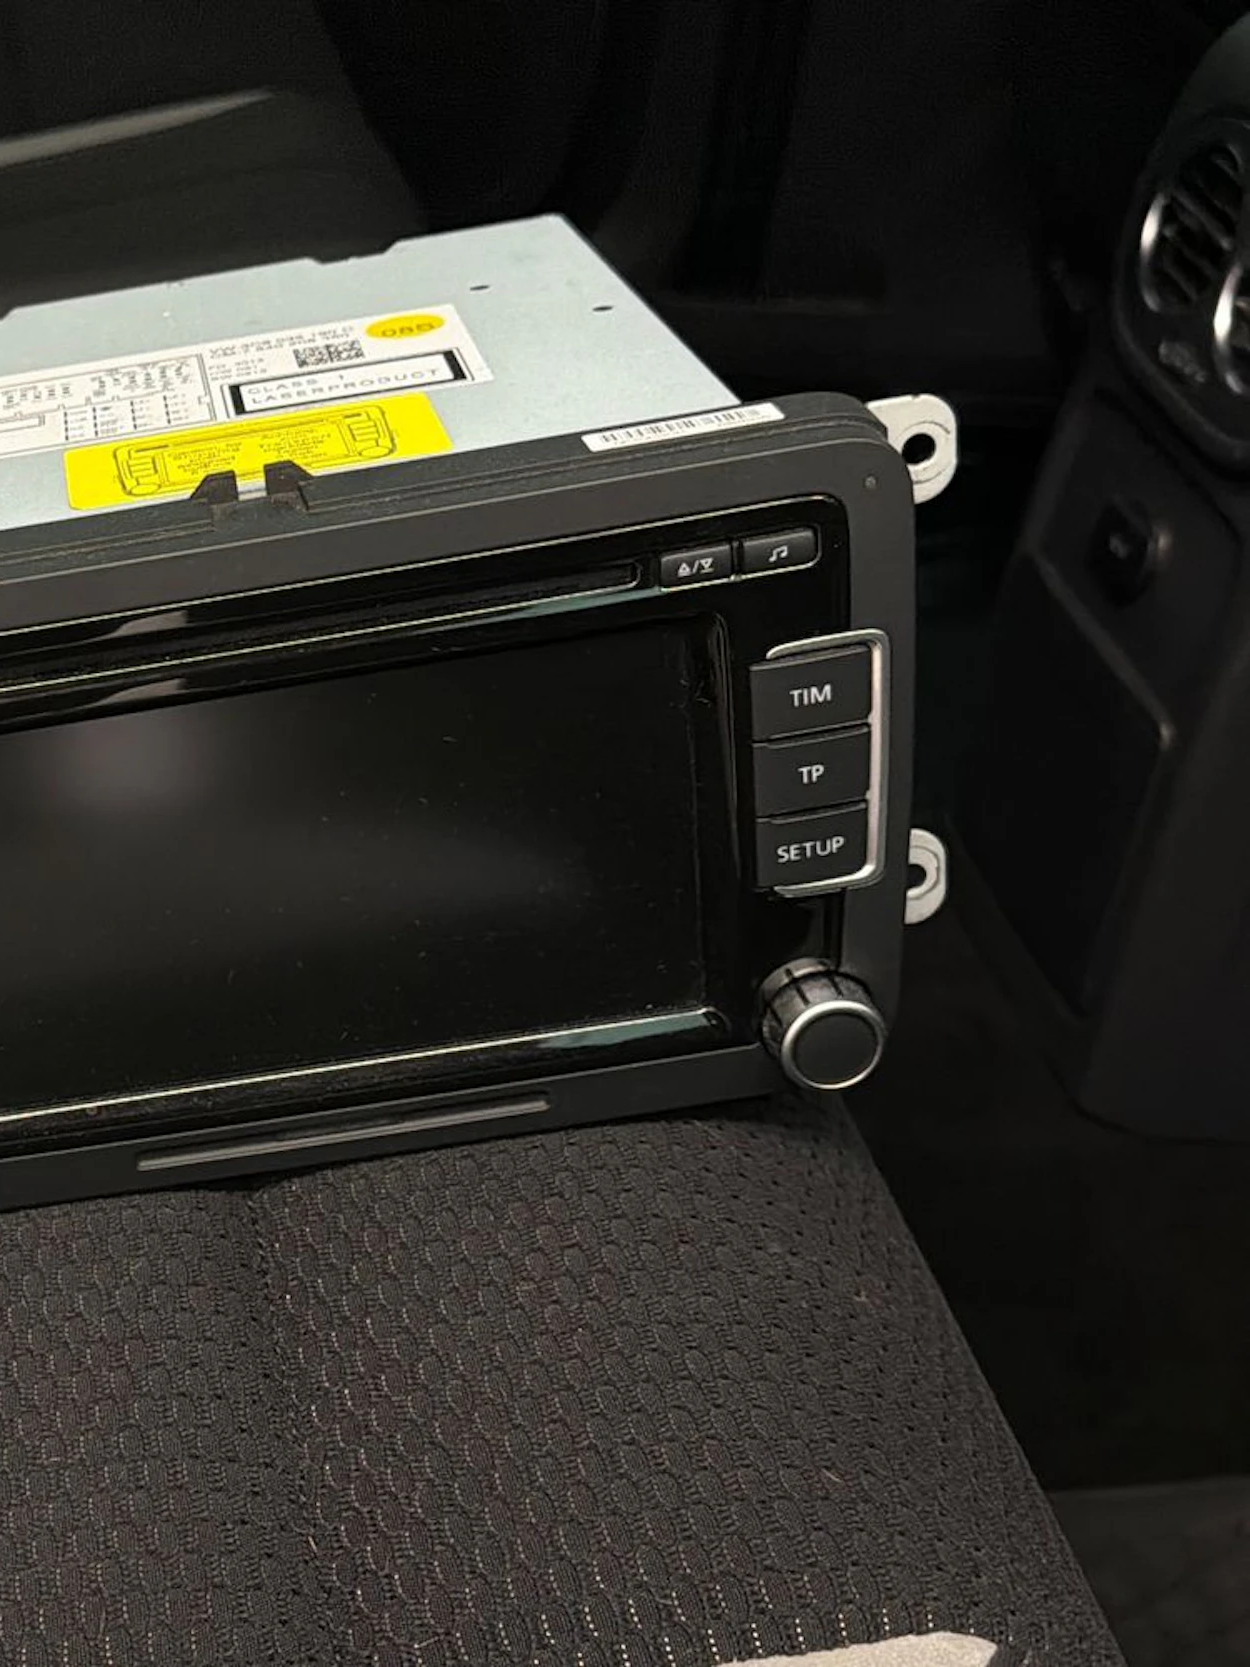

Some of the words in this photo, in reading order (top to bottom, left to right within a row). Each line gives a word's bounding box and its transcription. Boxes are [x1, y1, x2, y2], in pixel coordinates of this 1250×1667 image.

[247, 378, 318, 395] CLASS
[789, 683, 832, 707] TIM
[797, 763, 825, 785] TP
[776, 835, 845, 863] SETUP
